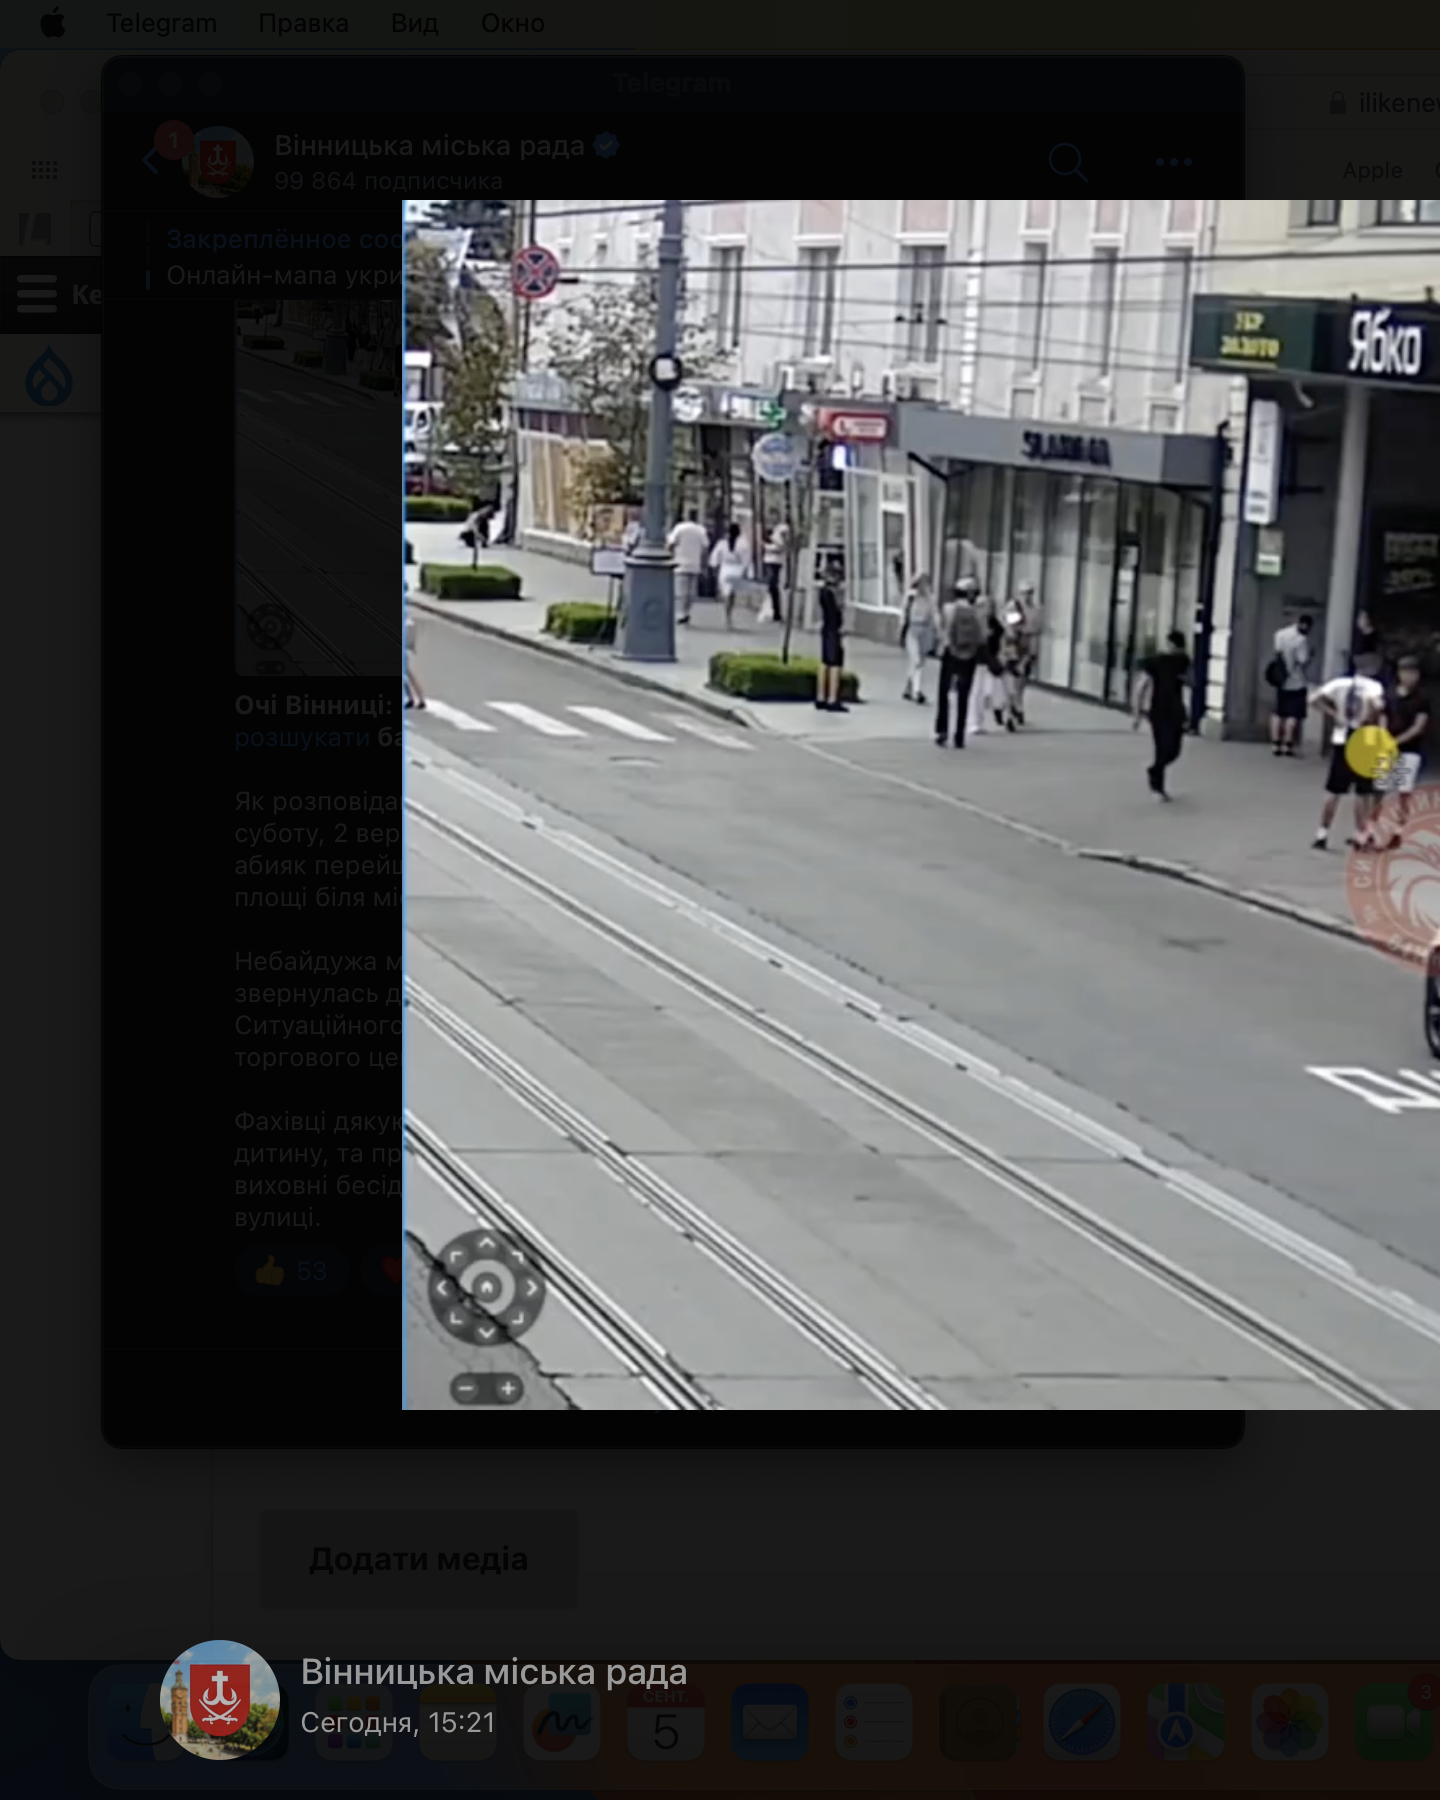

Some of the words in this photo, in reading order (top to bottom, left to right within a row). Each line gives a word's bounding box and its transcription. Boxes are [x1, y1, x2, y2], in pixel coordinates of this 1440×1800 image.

[107, 12, 216, 37] Telegram
[260, 13, 348, 37] Правка
[393, 13, 439, 36] Вид
[482, 13, 544, 34] Окно
[613, 72, 731, 97] Telegram
[168, 131, 178, 149] 1
[276, 133, 412, 160] Вінницька
[423, 133, 510, 156] міська
[521, 139, 585, 162] рада
[275, 171, 303, 191] 99
[312, 171, 356, 191] 864
[366, 175, 503, 194] подписчика
[1343, 161, 1402, 182] Apple
[167, 228, 351, 253] Закреплённое
[168, 264, 336, 286] Онлайн-мапа
[1349, 307, 1422, 376] Ябко
[235, 693, 277, 716] Очі
[286, 693, 392, 719] Вінниці:
[235, 731, 370, 752] розшукати
[235, 791, 265, 811] Як
[274, 790, 402, 816] розповіда
[235, 822, 324, 848] суботу,
[335, 823, 348, 843] 2
[358, 827, 400, 848] вер
[235, 854, 307, 875] абияк
[235, 886, 307, 911] площі
[316, 886, 365, 907] біля
[375, 886, 402, 907] мі
[236, 949, 377, 976] Небайдужа
[235, 987, 379, 1008] звернулась
[386, 987, 402, 1007] д
[235, 1051, 361, 1072] торгового
[370, 1051, 402, 1071] це
[235, 1110, 326, 1135] Фахівці
[234, 1147, 328, 1168] дитину,
[337, 1147, 363, 1163] та
[372, 1147, 402, 1168] пр
[235, 1174, 327, 1195] виховні
[235, 1206, 321, 1232] вулиці.
[297, 1260, 327, 1281] 53
[309, 1547, 428, 1576] Додати
[437, 1545, 528, 1573] медіа
[303, 1656, 474, 1690] Вінницька
[485, 1656, 595, 1686] міська
[607, 1663, 687, 1692] рада
[642, 1689, 689, 1704] СЕНТ.
[1420, 1684, 1432, 1701] 3
[302, 1711, 419, 1738] Сегодня,
[430, 1711, 493, 1734] 15:21
[653, 1713, 679, 1750] 5
